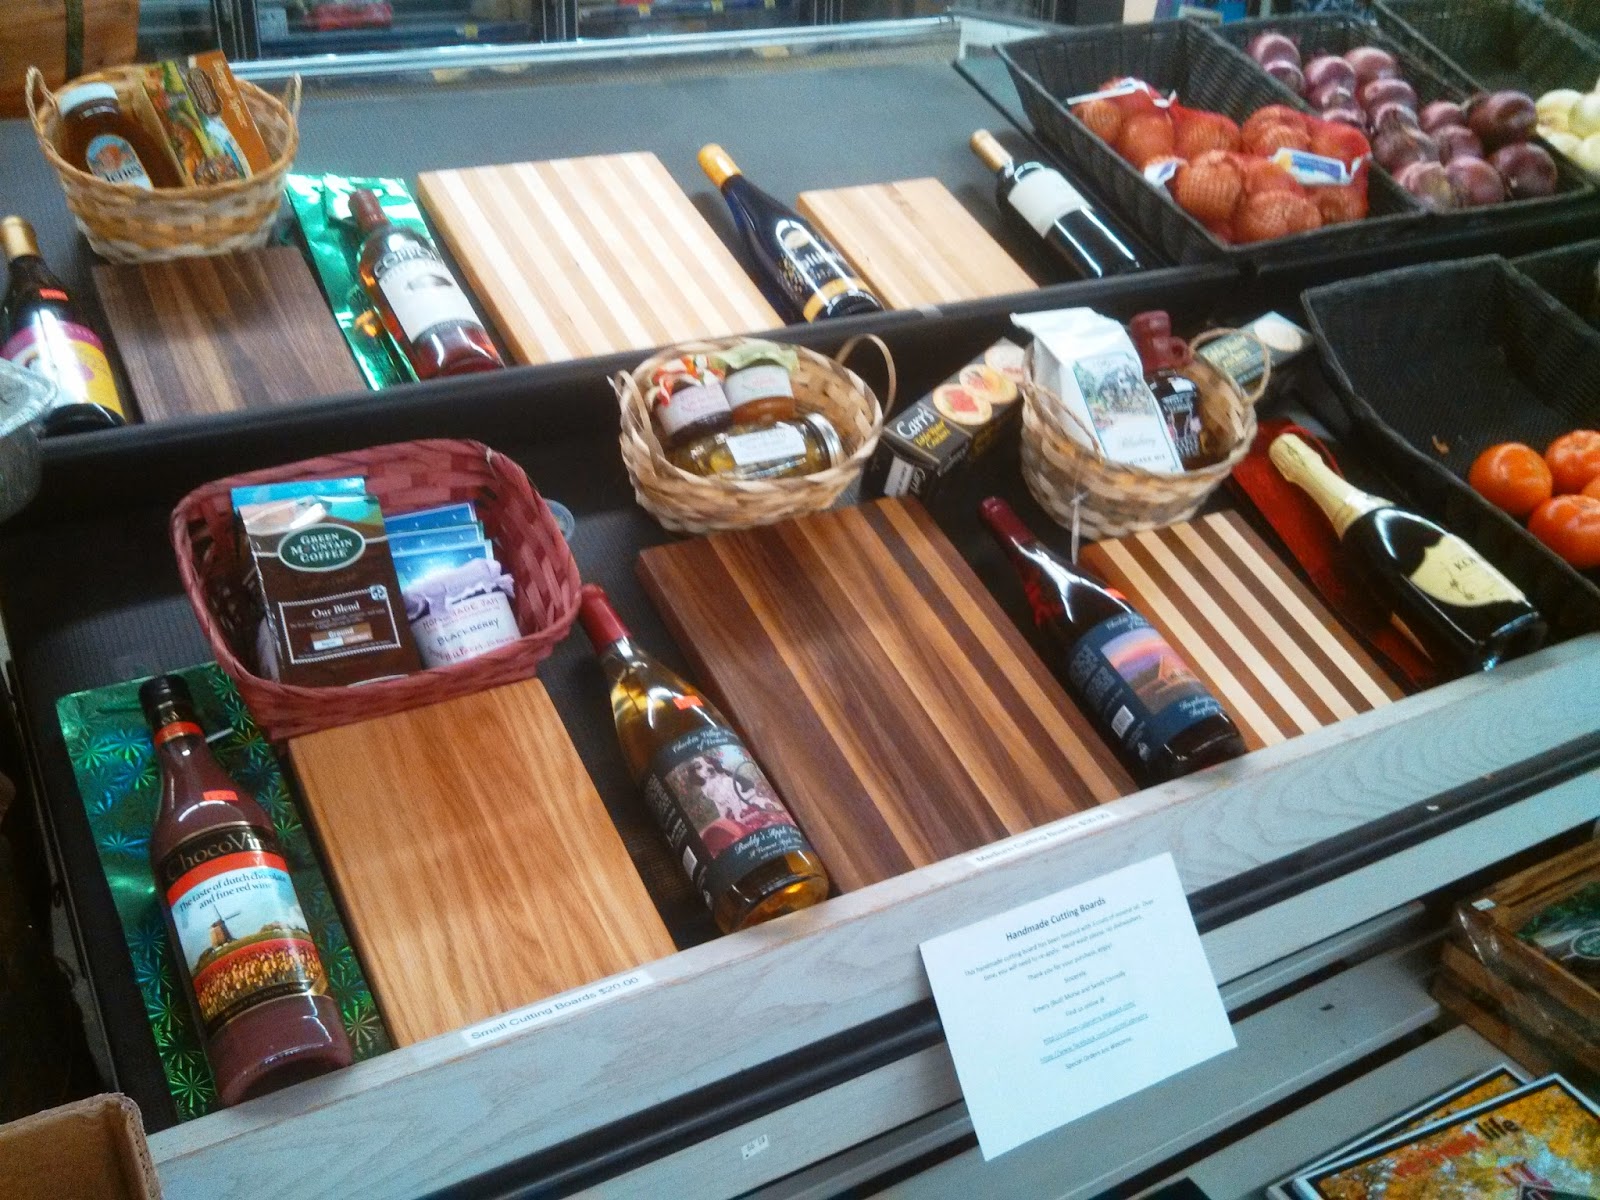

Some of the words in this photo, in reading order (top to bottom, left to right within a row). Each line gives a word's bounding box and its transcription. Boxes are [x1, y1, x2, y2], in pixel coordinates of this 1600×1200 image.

[290, 539, 353, 557] MOUNTAIN
[300, 532, 340, 545] GREEN
[300, 549, 348, 564] COFFEE
[311, 606, 333, 619] Our
[334, 601, 360, 616] Blend
[437, 618, 499, 647] BLACKBERRY
[180, 900, 192, 912] The
[192, 886, 213, 902] taste
[213, 882, 223, 891] of
[223, 873, 251, 887] dutch
[199, 896, 216, 909] and
[216, 888, 236, 900] fine
[235, 882, 252, 893] red
[252, 881, 273, 889] wine
[1005, 918, 1050, 941] Handmade
[1050, 906, 1080, 924] Cutting
[1079, 896, 1107, 913] Boards
[471, 1021, 508, 1040] Small
[509, 1007, 553, 1027] Cutting
[554, 992, 597, 1010] Boards
[598, 976, 639, 995] $20.00
